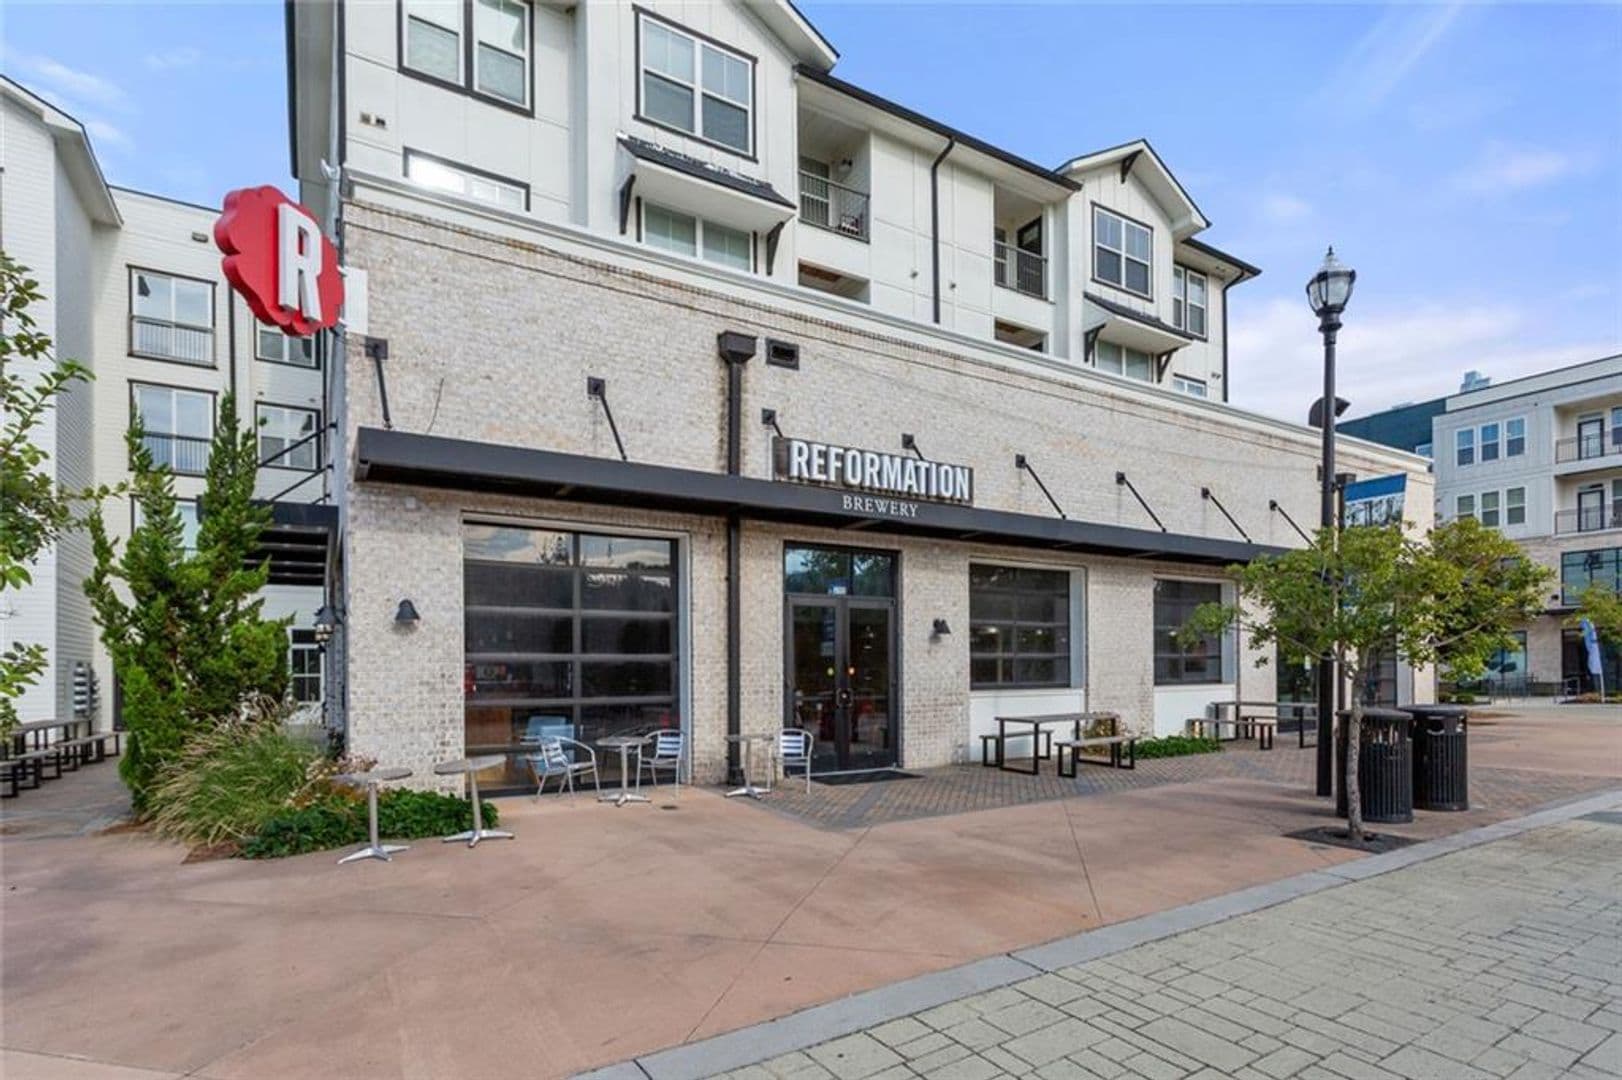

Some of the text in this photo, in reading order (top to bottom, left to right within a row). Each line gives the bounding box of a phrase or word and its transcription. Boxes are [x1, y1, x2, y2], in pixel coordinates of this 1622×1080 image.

[278, 203, 322, 322] R
[789, 440, 970, 500] REFORMATION
[842, 495, 919, 518] BREWERY
